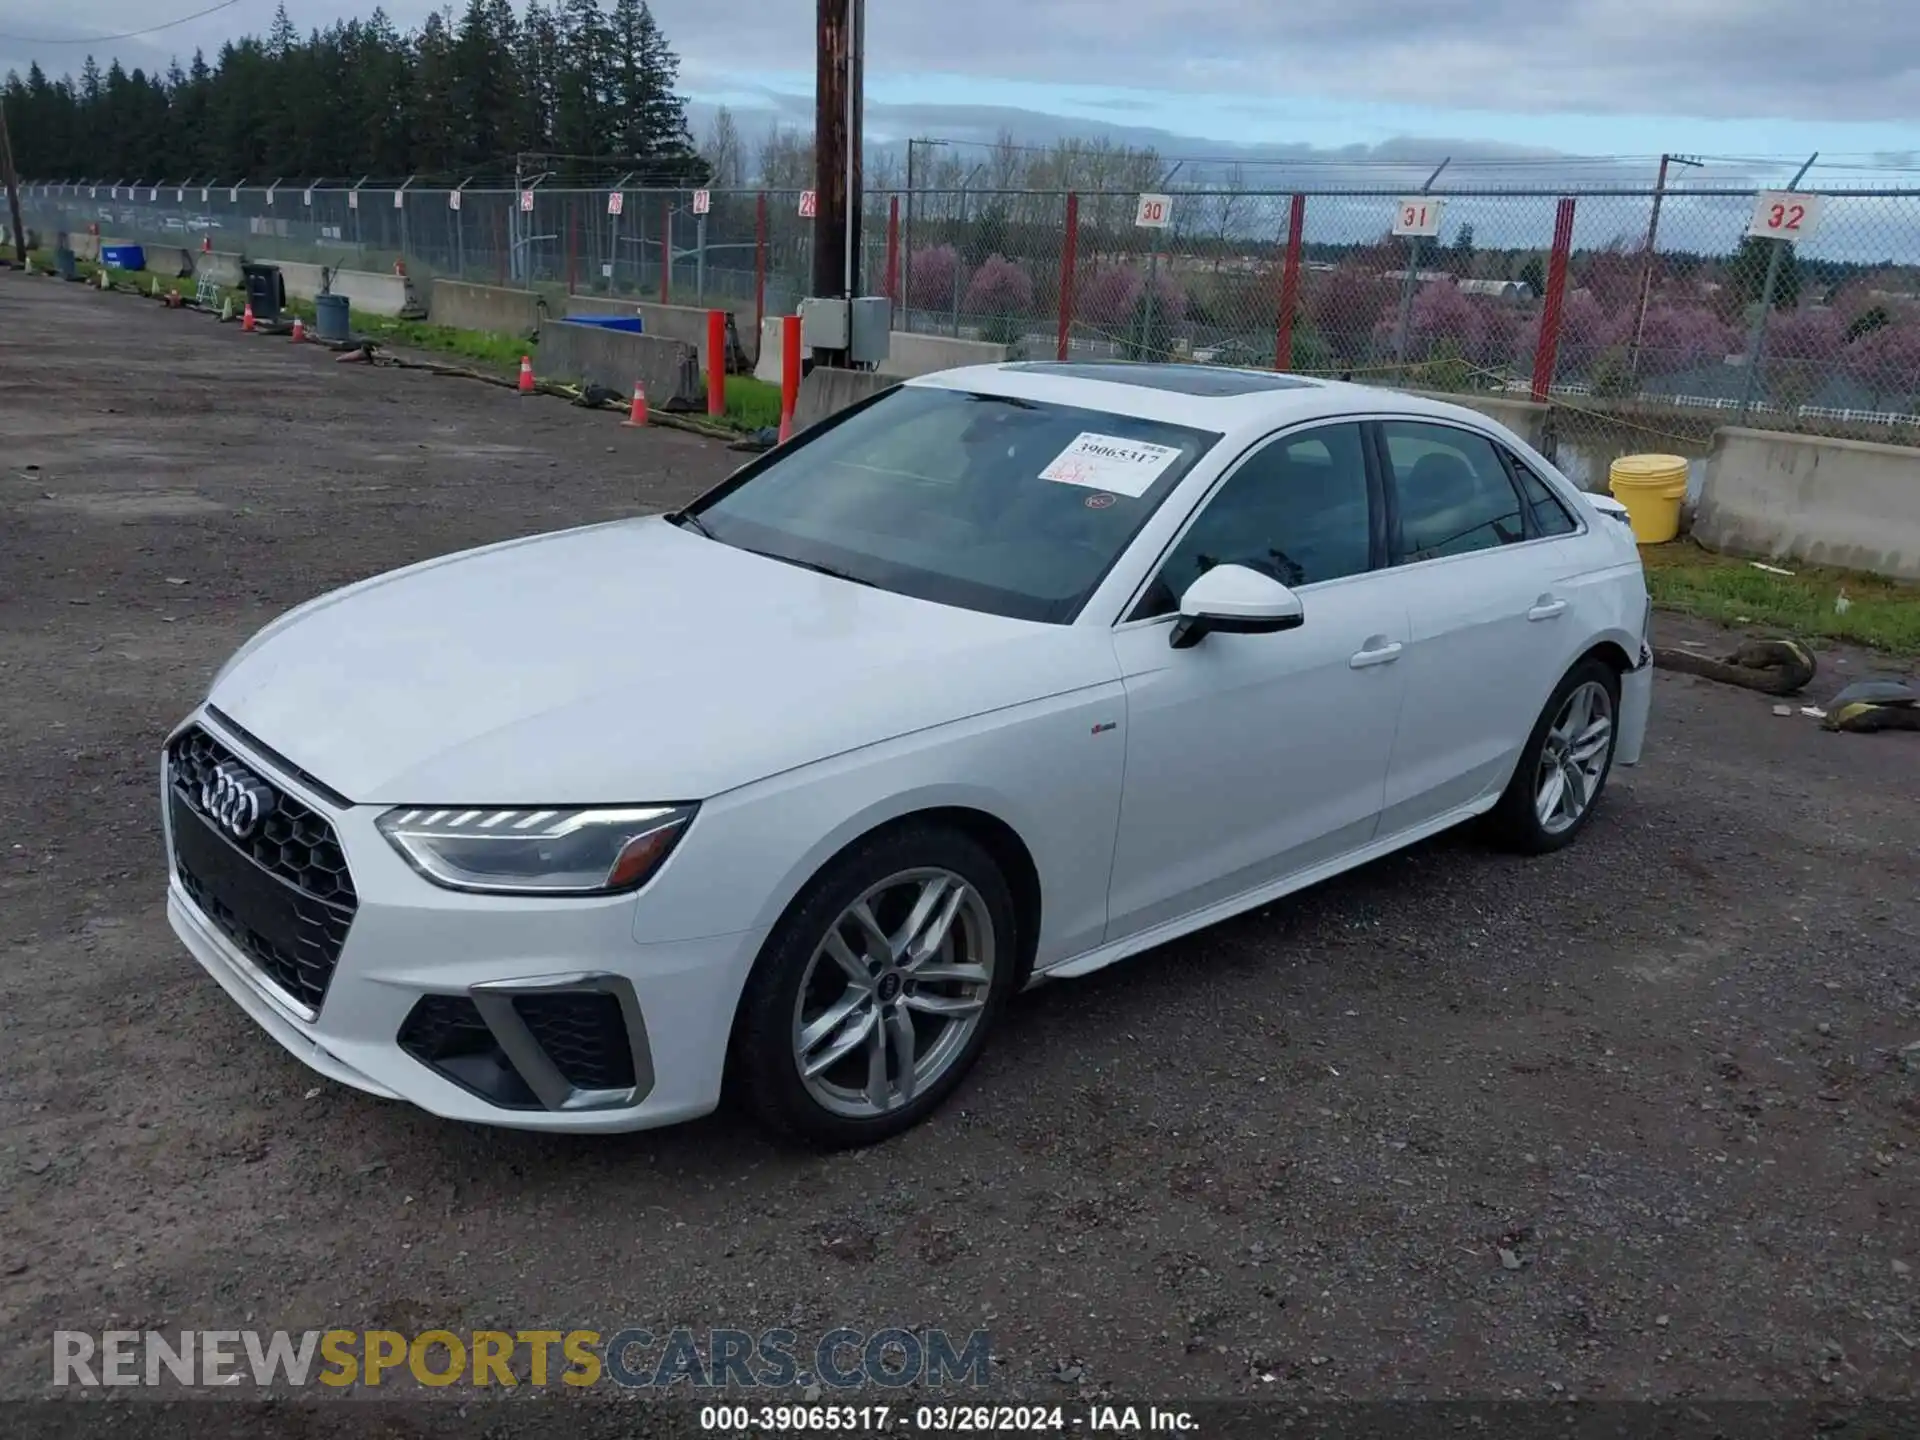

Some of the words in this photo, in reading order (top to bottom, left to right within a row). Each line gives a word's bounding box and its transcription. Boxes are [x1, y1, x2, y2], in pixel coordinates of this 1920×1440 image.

[695, 190, 708, 212] 27
[1143, 201, 1162, 220] 30
[1404, 206, 1426, 227] 31
[1767, 203, 1805, 229] 32
